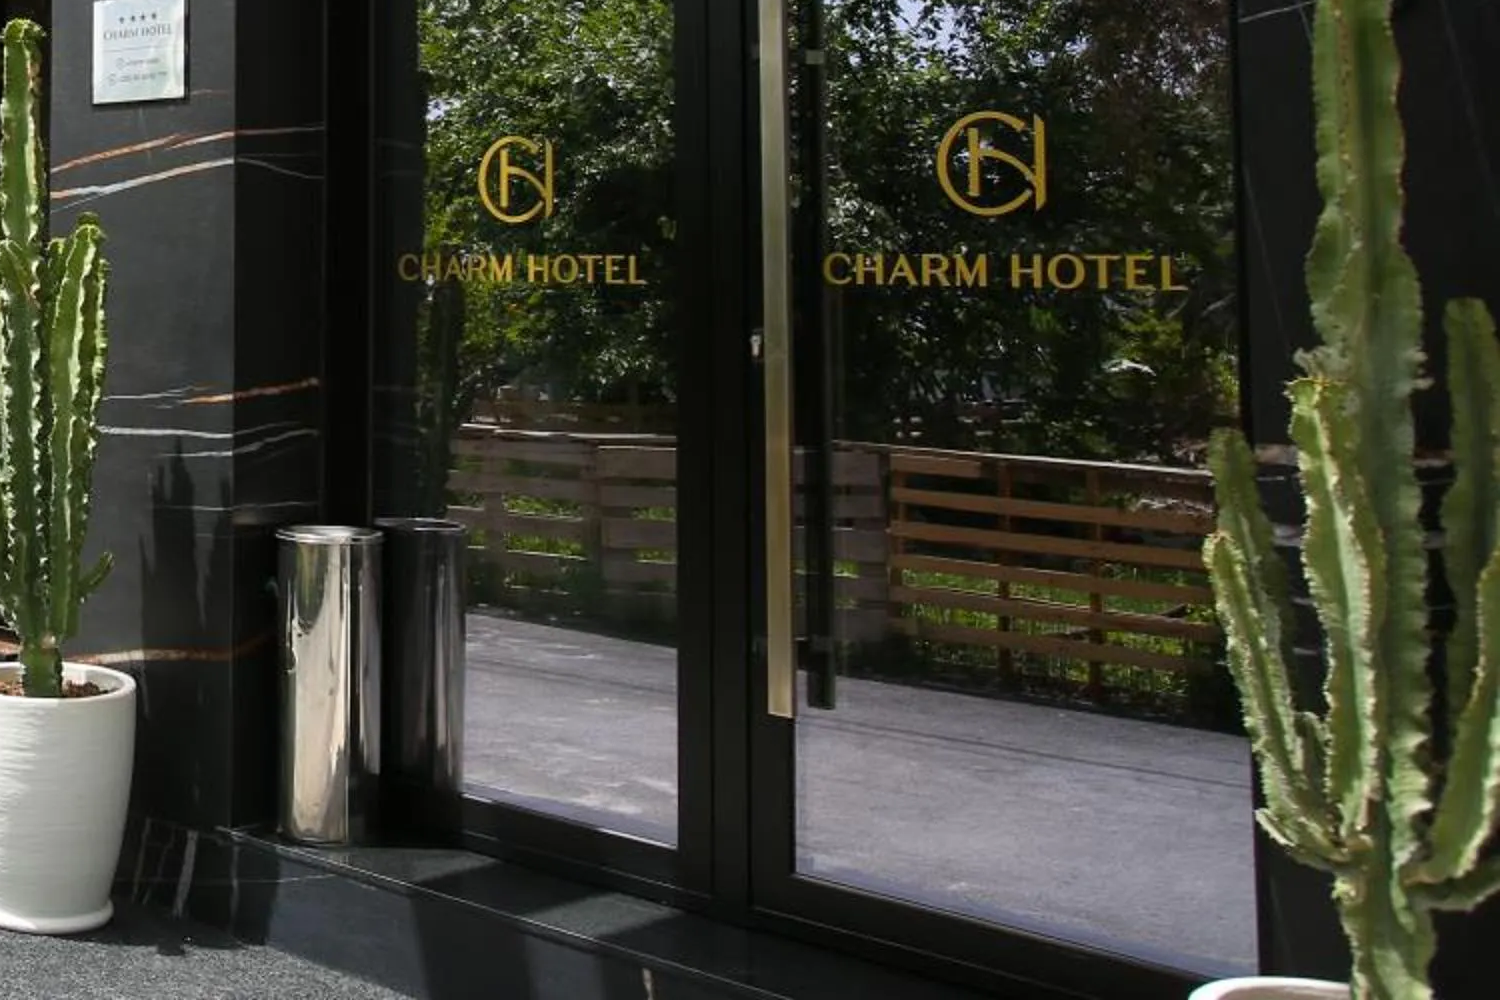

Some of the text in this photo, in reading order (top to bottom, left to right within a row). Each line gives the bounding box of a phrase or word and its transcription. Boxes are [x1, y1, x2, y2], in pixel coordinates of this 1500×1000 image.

[398, 253, 649, 285] CHARM HOTEL
[822, 252, 1190, 291] CHARM HOTEL
